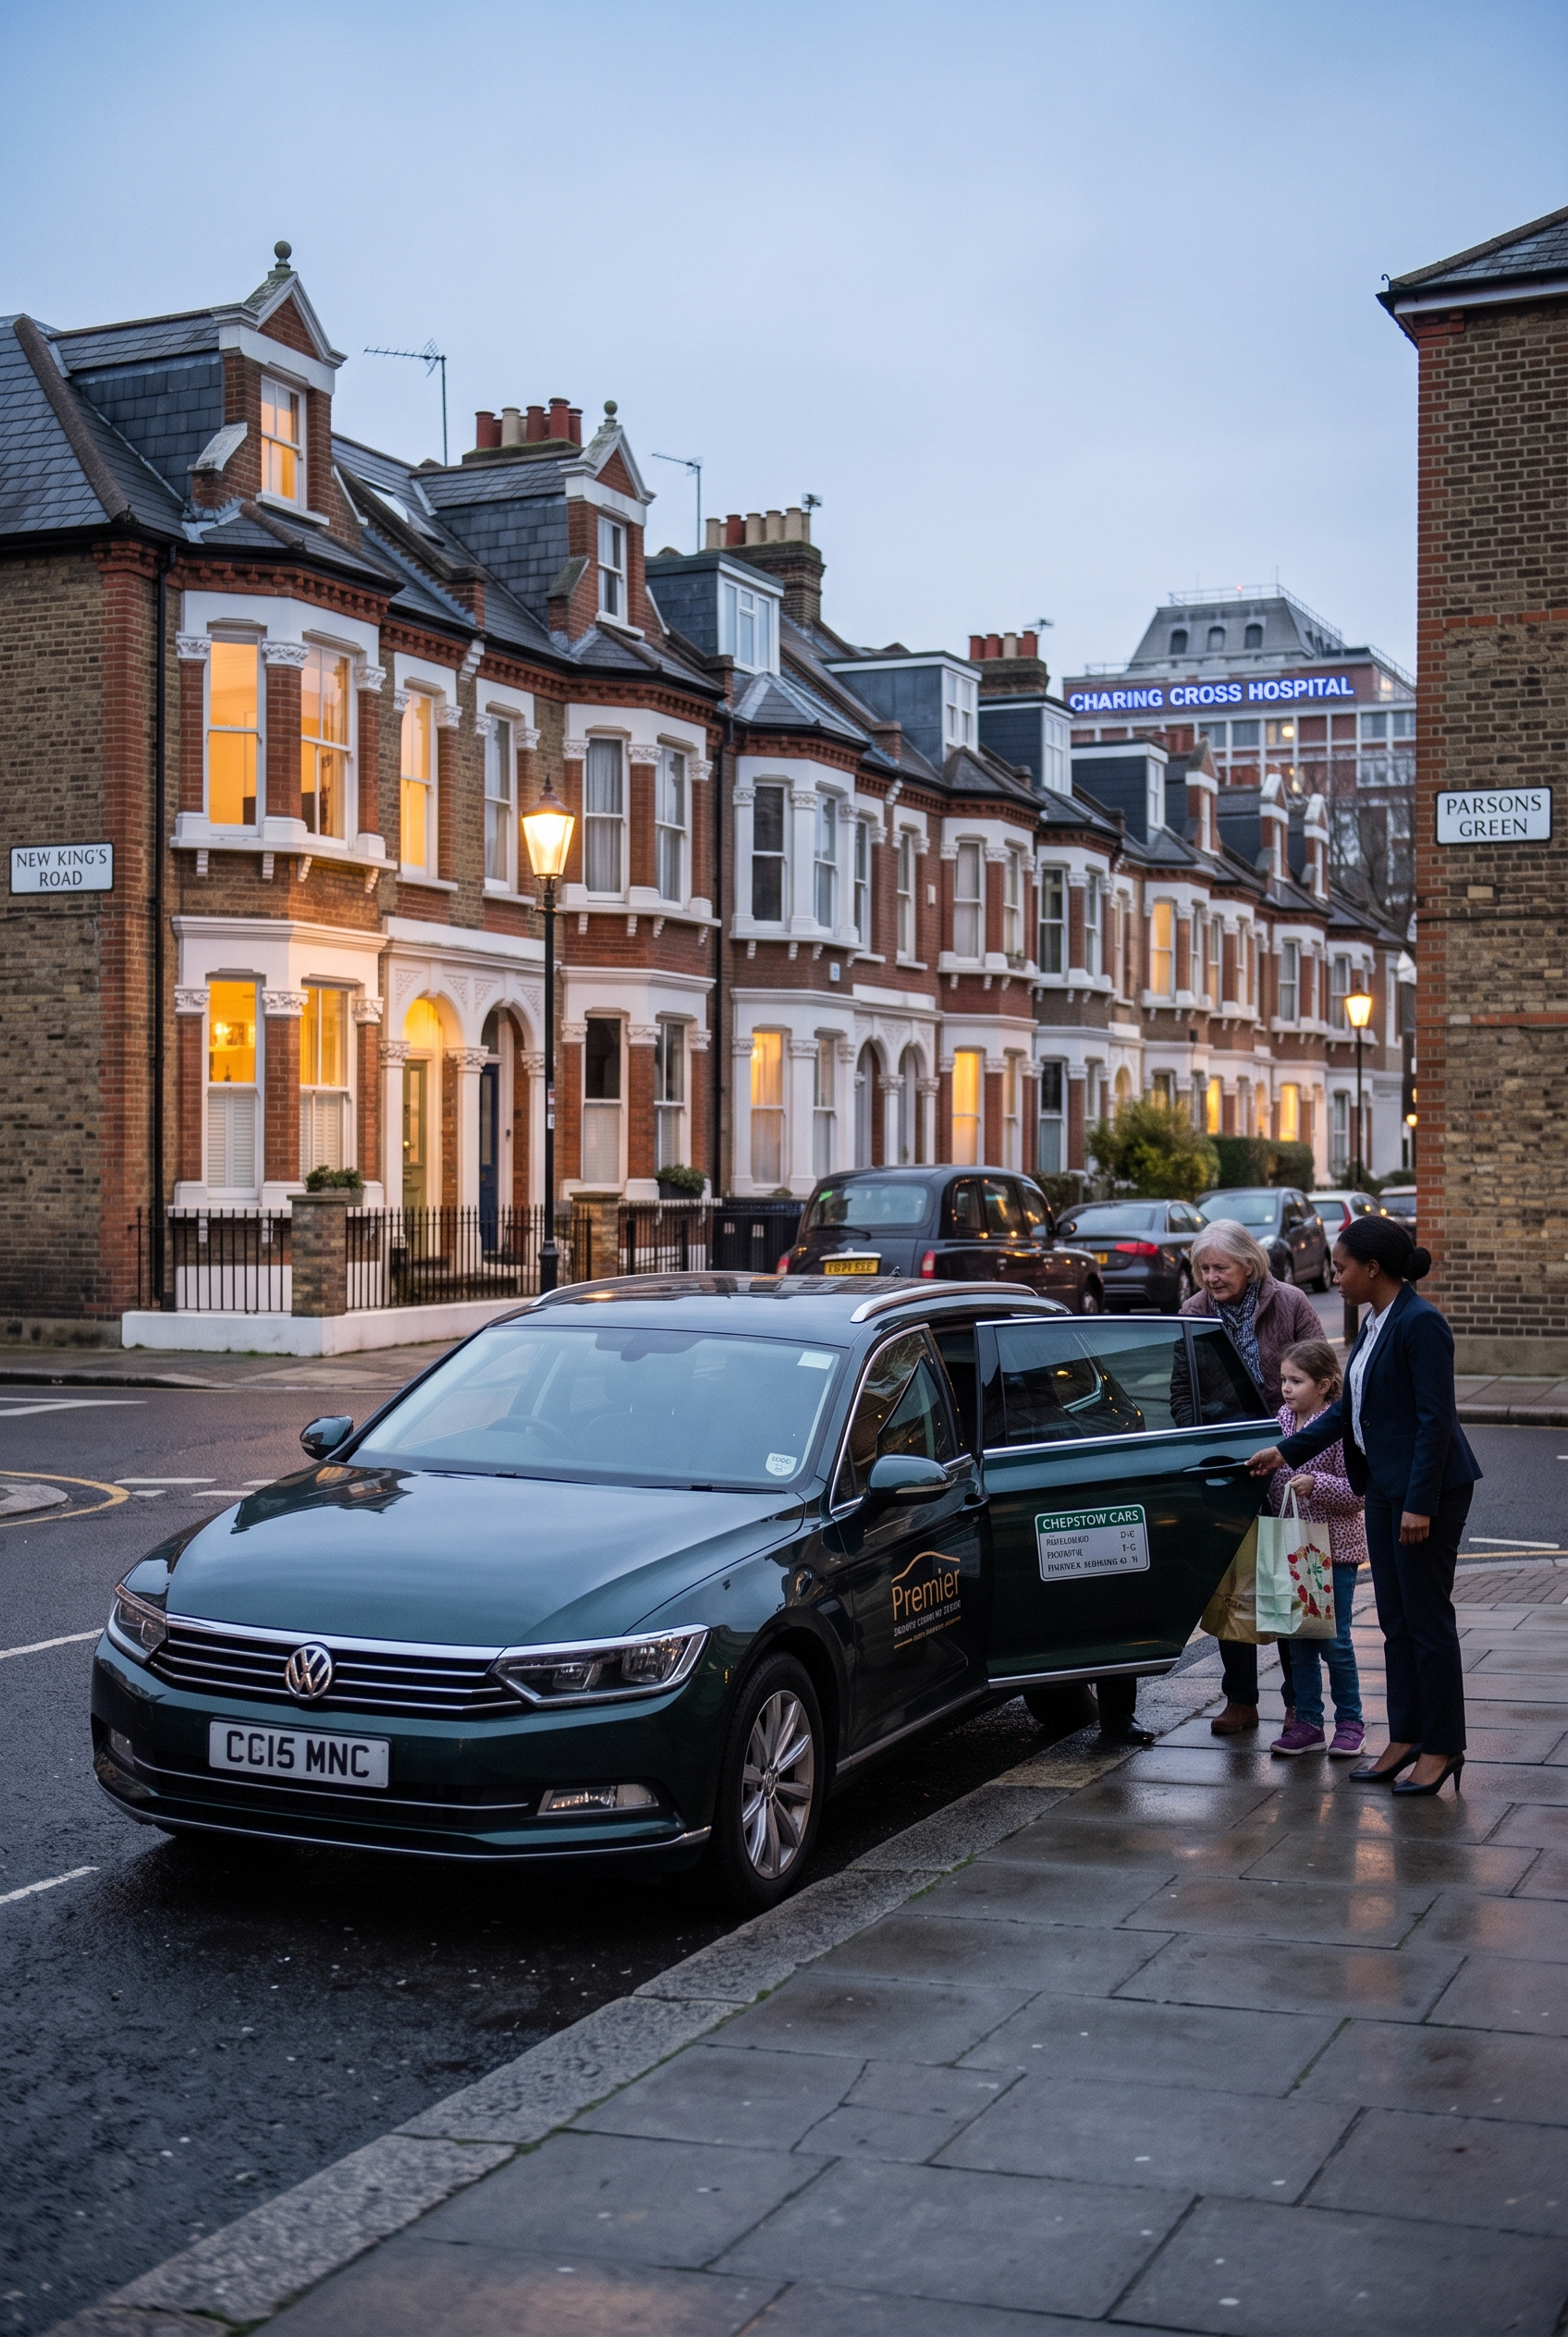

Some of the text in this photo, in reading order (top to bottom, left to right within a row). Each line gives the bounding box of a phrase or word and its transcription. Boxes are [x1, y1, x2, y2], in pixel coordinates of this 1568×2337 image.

[1069, 677, 1354, 712] CHARING CROSS HOSPITAL
[1447, 794, 1542, 815] PARSONS
[1459, 818, 1527, 837] GREEN
[17, 849, 107, 868] NEW KING'S
[39, 871, 82, 887] ROAD
[1042, 1511, 1139, 1530] CHEPSTOW CARS
[891, 1567, 961, 1621] Premier
[305, 1739, 370, 1779] MNC
